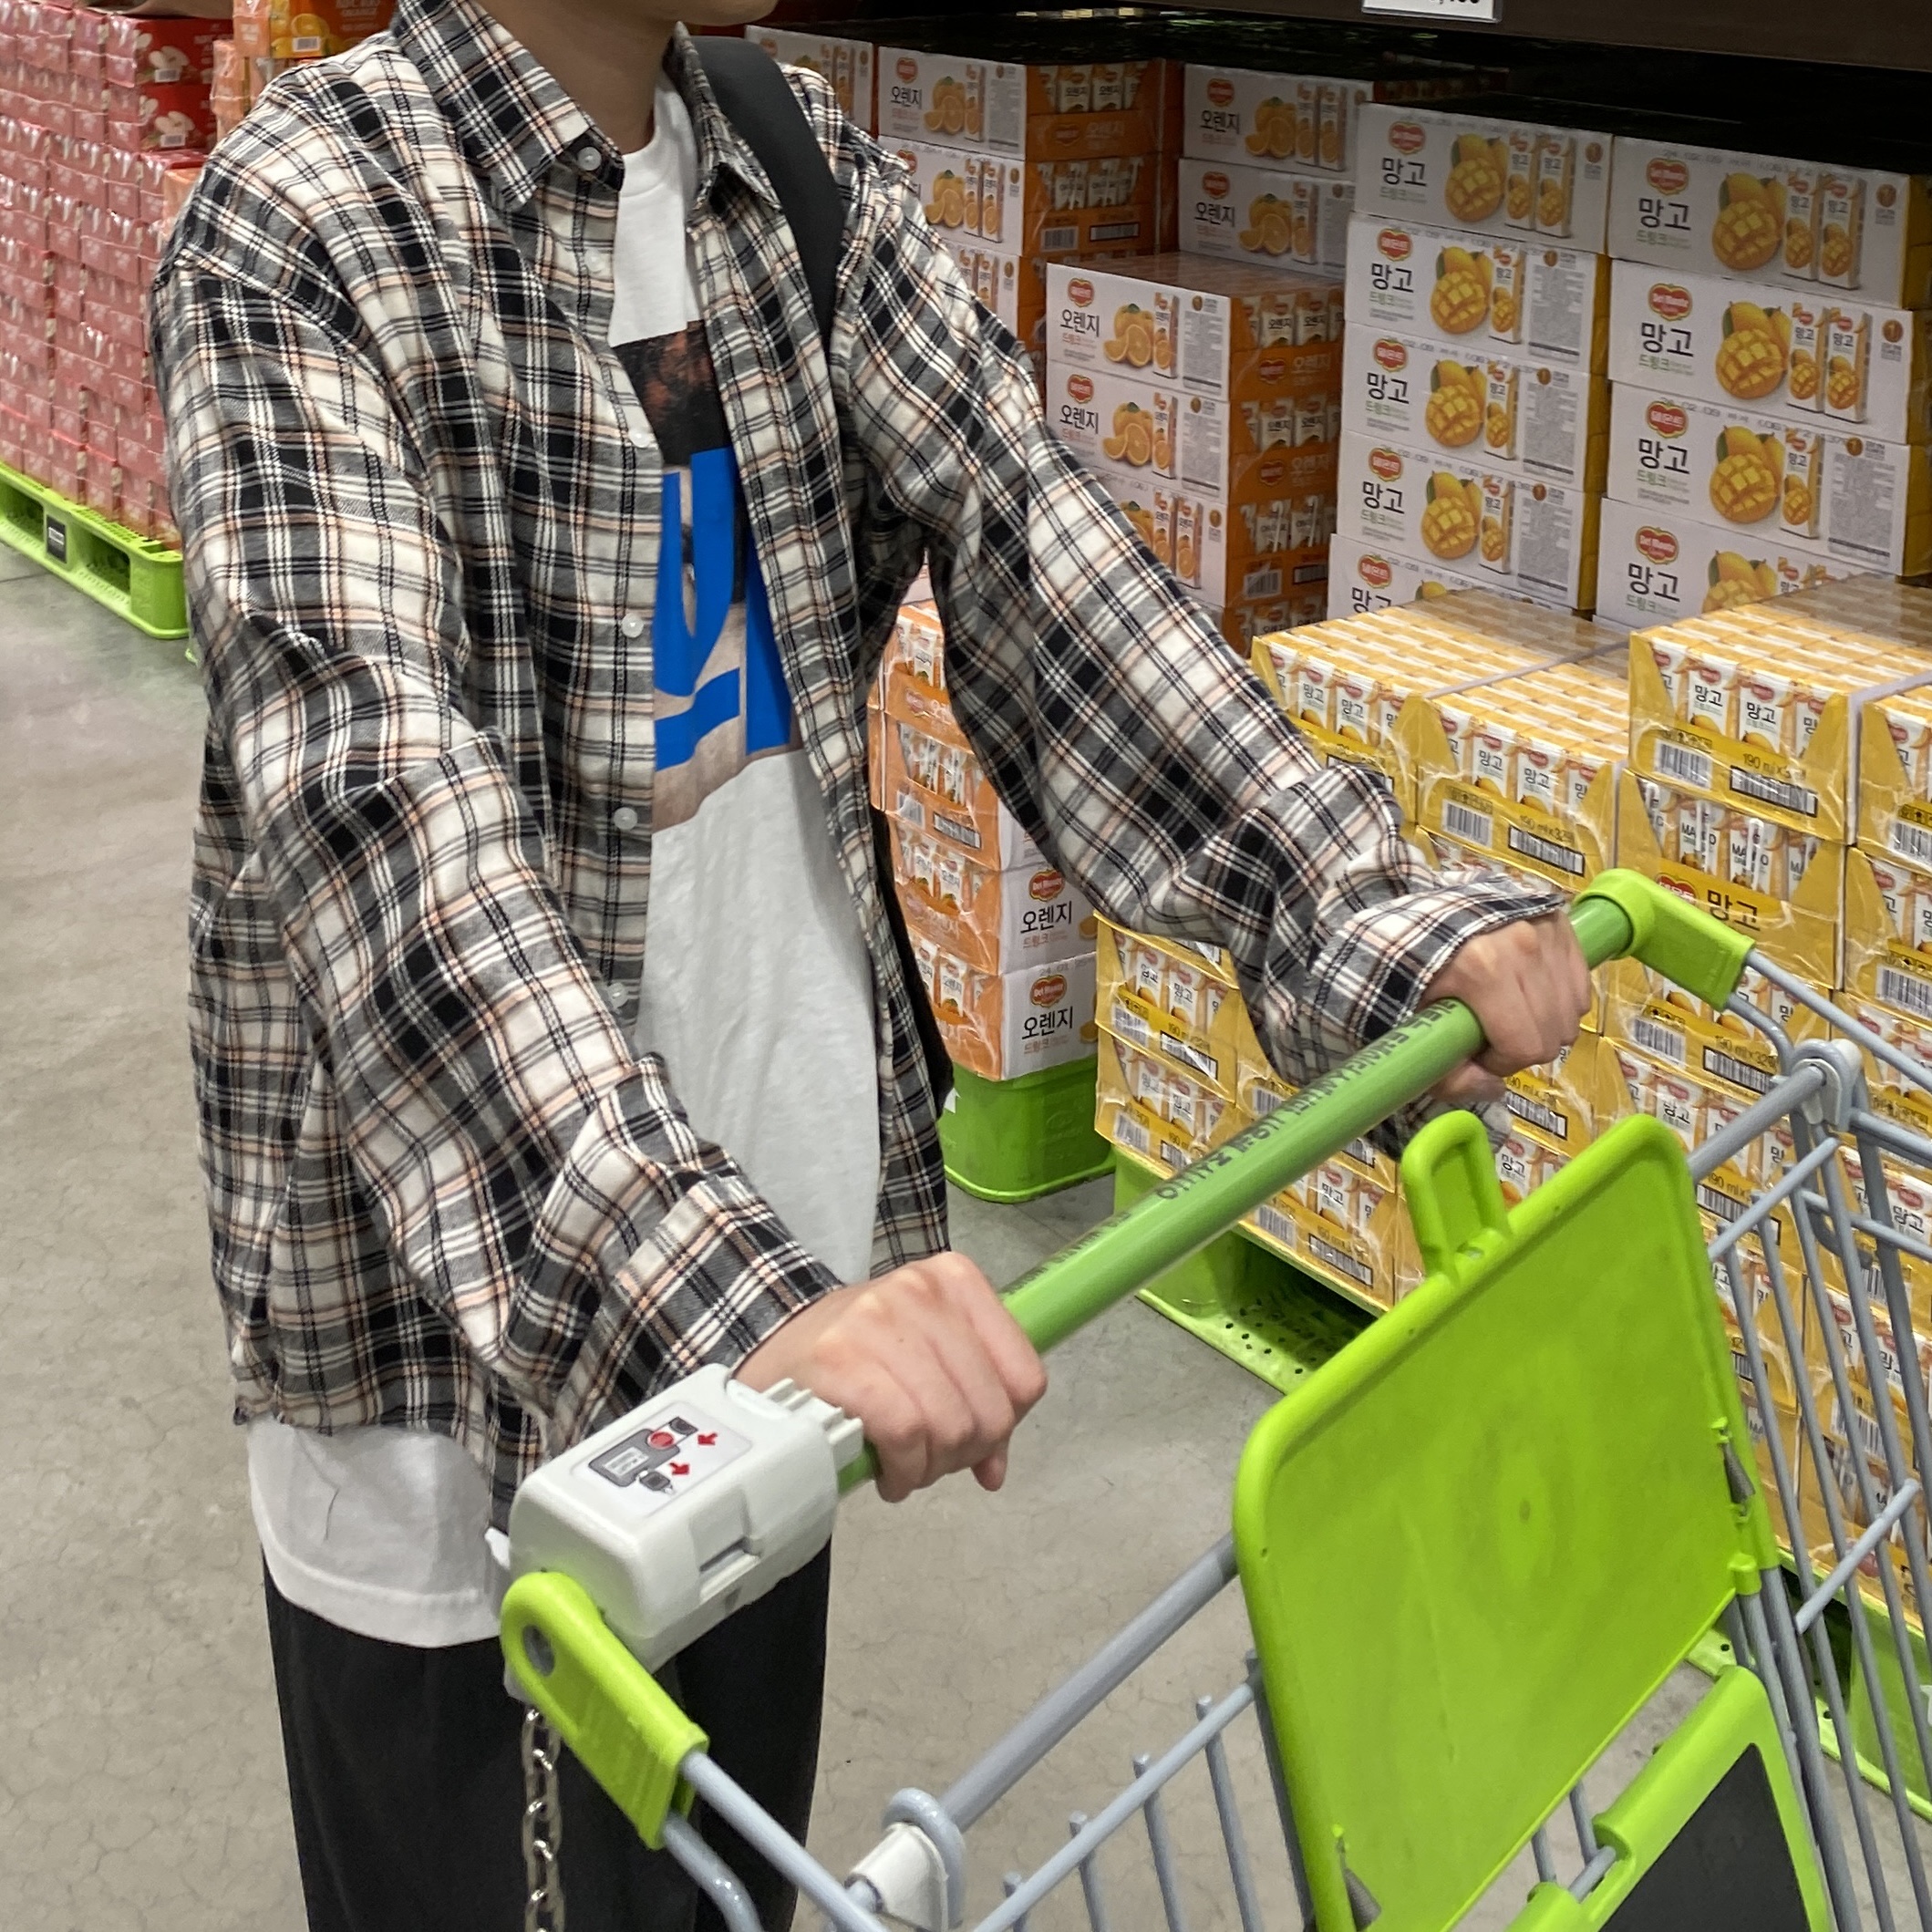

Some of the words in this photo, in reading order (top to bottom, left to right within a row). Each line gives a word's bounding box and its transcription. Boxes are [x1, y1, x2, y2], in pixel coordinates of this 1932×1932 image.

[1200, 109, 1240, 134] 오렌지
[1382, 157, 1427, 187] 망고
[1194, 201, 1235, 227] 오렌지
[1638, 198, 1691, 231] 망고
[1371, 263, 1414, 293] 망고
[1059, 309, 1100, 337] 오렌지
[1641, 322, 1694, 357] 망고
[1367, 372, 1410, 405] 망고
[1059, 404, 1099, 434] 오렌지
[1638, 438, 1689, 475] 망고
[1363, 481, 1405, 514] 망고
[1628, 563, 1680, 603] 망고
[1304, 683, 1324, 703] 망고
[1695, 685, 1723, 708] 망고
[1342, 698, 1364, 718] 망고
[1747, 702, 1776, 725] 망고
[1480, 749, 1503, 770] 망고
[1743, 753, 1761, 770] 190
[1524, 769, 1549, 789] 망고
[1020, 901, 1072, 934] 오렌지
[1708, 889, 1761, 931] 망고
[1022, 1007, 1073, 1039] 오렌지
[1502, 1154, 1525, 1178] 망고
[1709, 1173, 1724, 1186] 190
[1893, 1205, 1924, 1234] 망고
